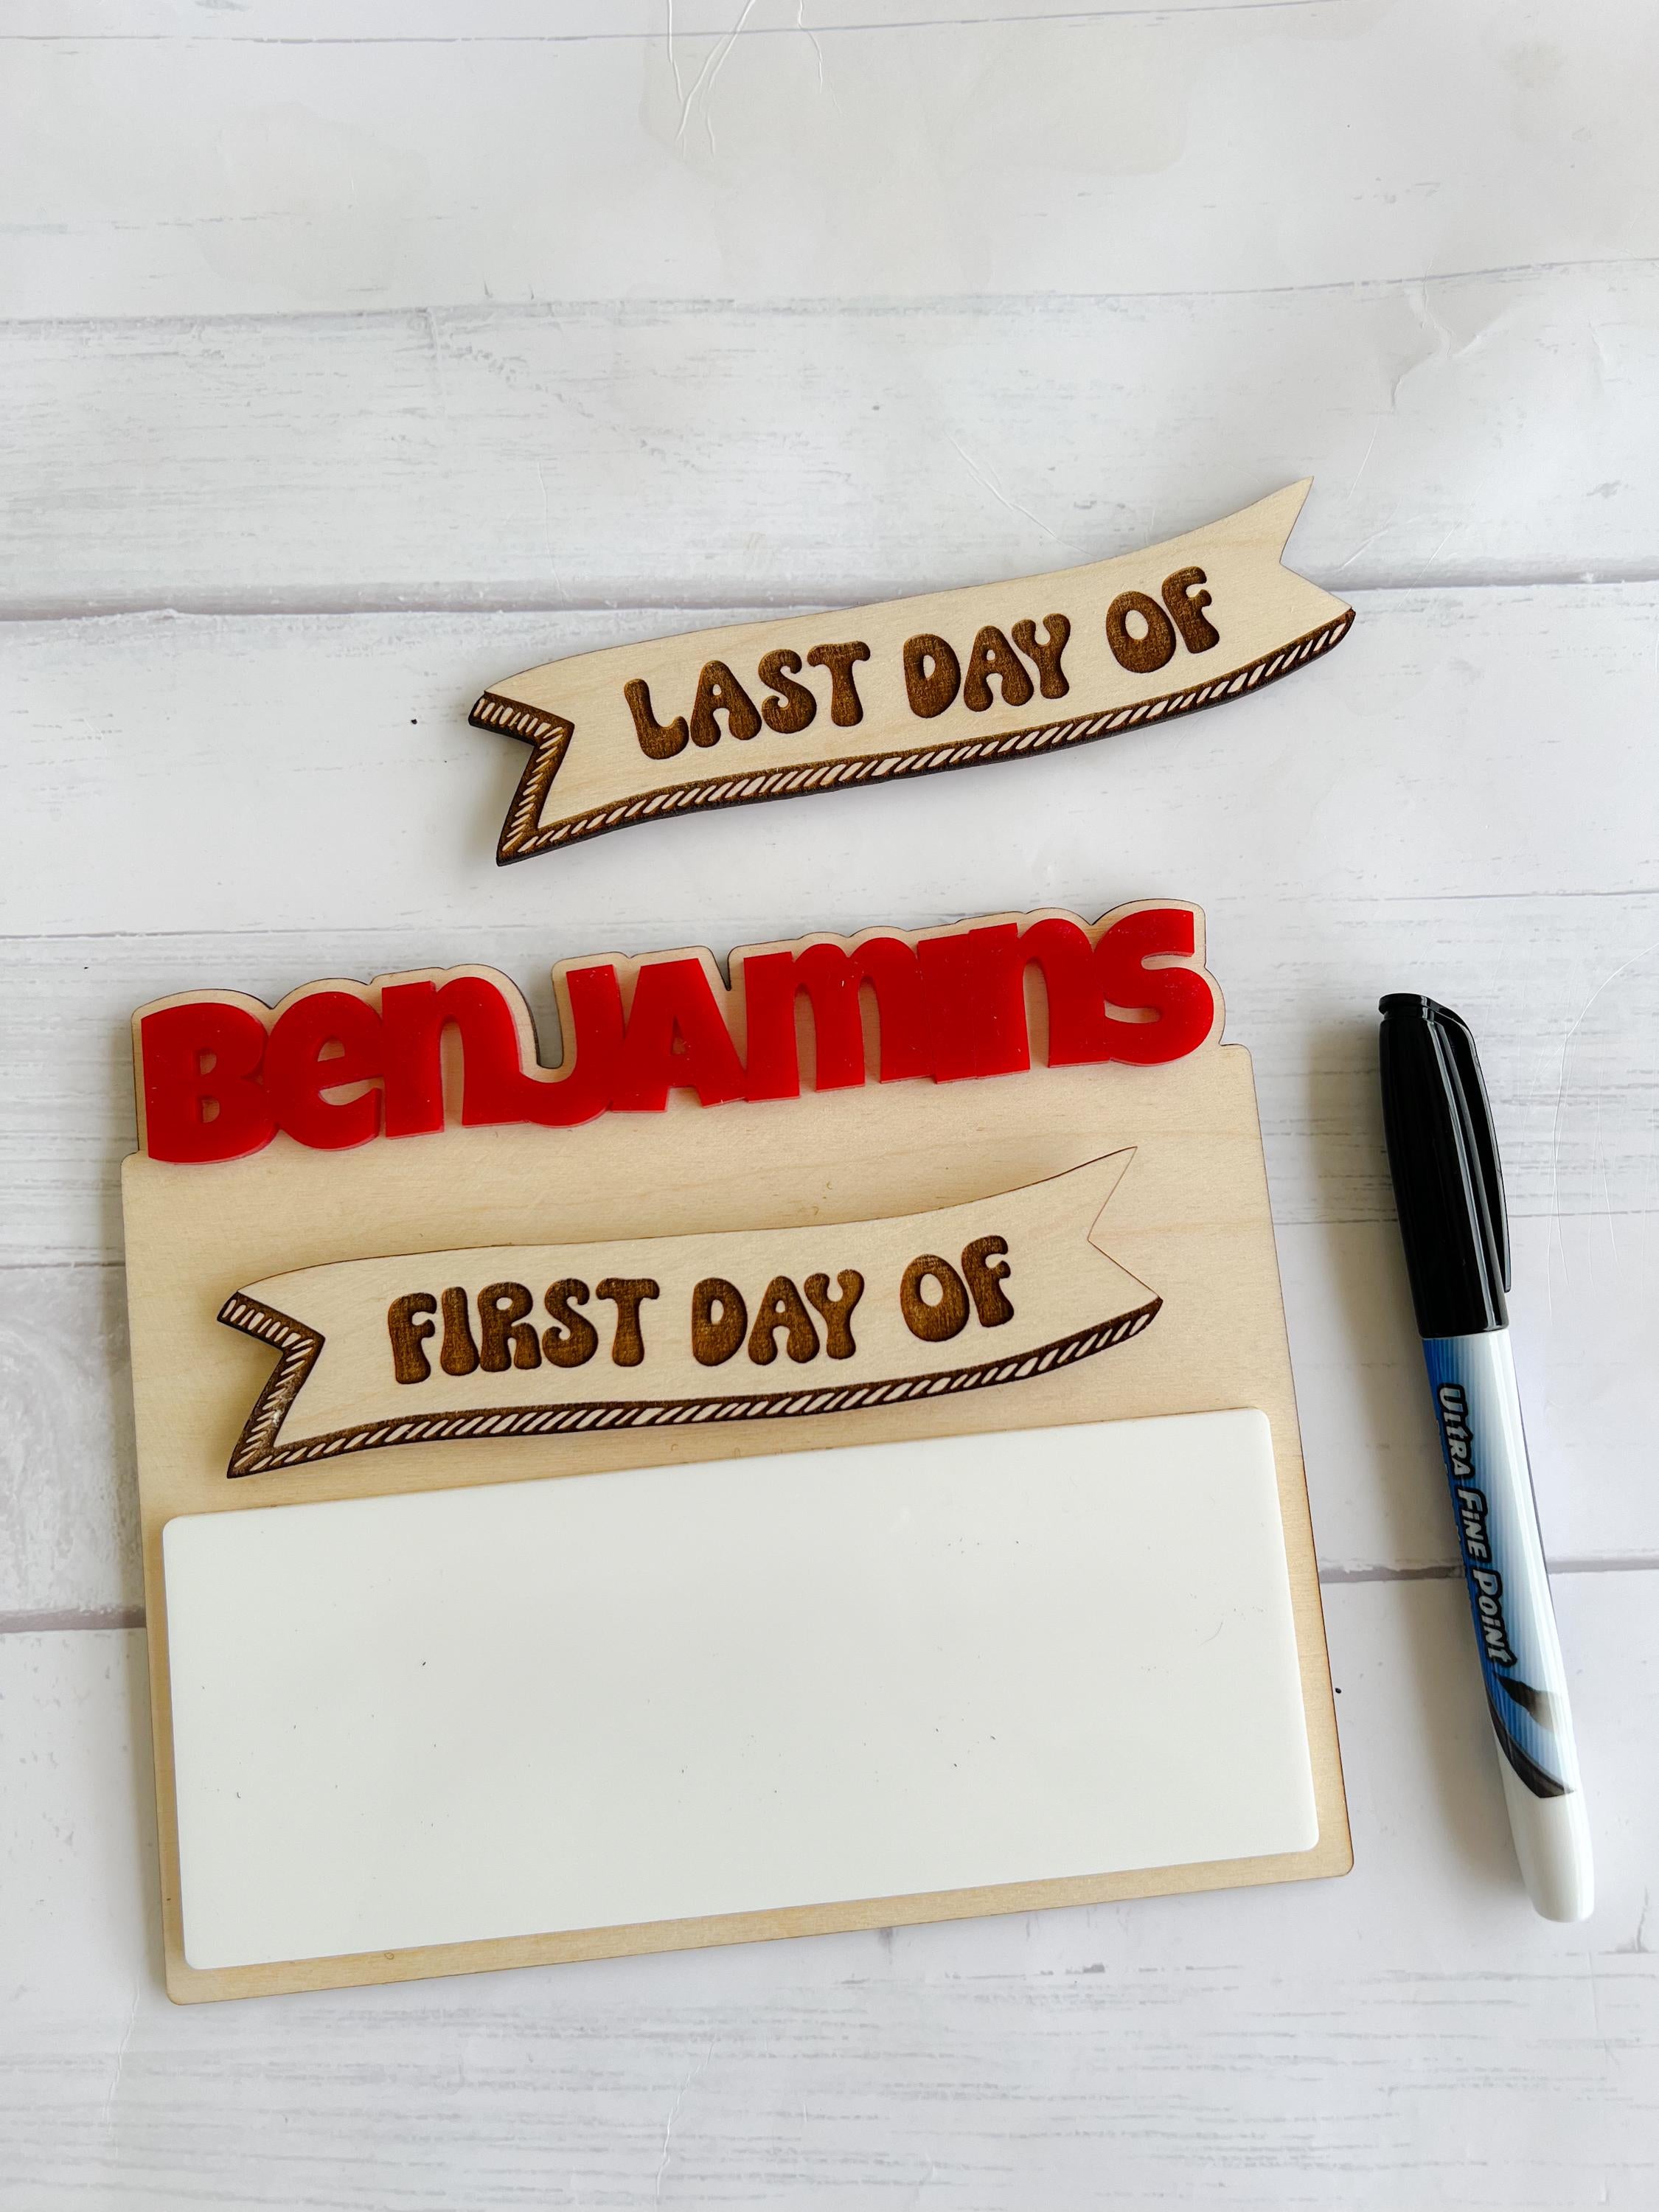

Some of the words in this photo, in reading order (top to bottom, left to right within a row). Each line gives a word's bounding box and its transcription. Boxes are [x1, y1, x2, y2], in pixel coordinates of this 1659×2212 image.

[623, 640, 872, 761] LAST
[902, 613, 1071, 720] DAY
[1105, 566, 1221, 675] OF
[388, 1277, 661, 1385] FIRST
[690, 1269, 866, 1368] DAY
[899, 1234, 1016, 1343] OF
